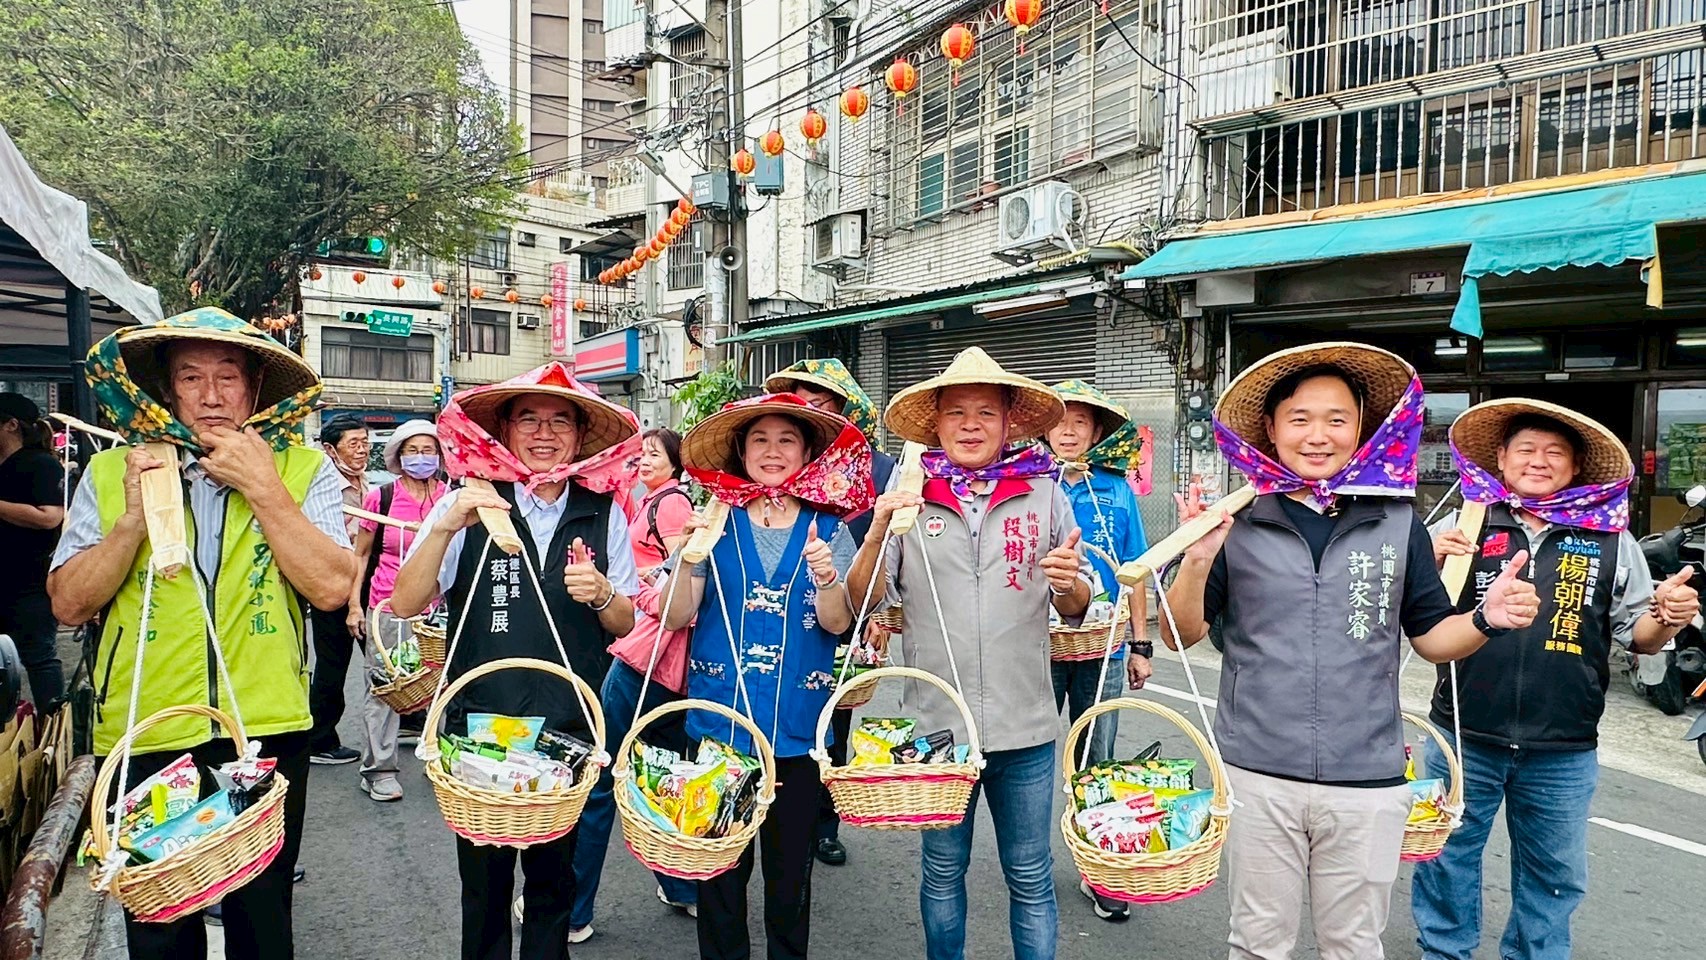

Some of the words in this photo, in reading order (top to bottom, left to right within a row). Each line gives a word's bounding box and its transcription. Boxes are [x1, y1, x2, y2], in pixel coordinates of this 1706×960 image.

[1426, 281, 1435, 292] 7
[1002, 516, 1027, 591] 段樹文
[1378, 543, 1397, 627] 桃園市議員
[1556, 541, 1601, 556] Taoyuan
[1346, 550, 1376, 640] 許家睿
[1549, 552, 1589, 641] 楊朝偉
